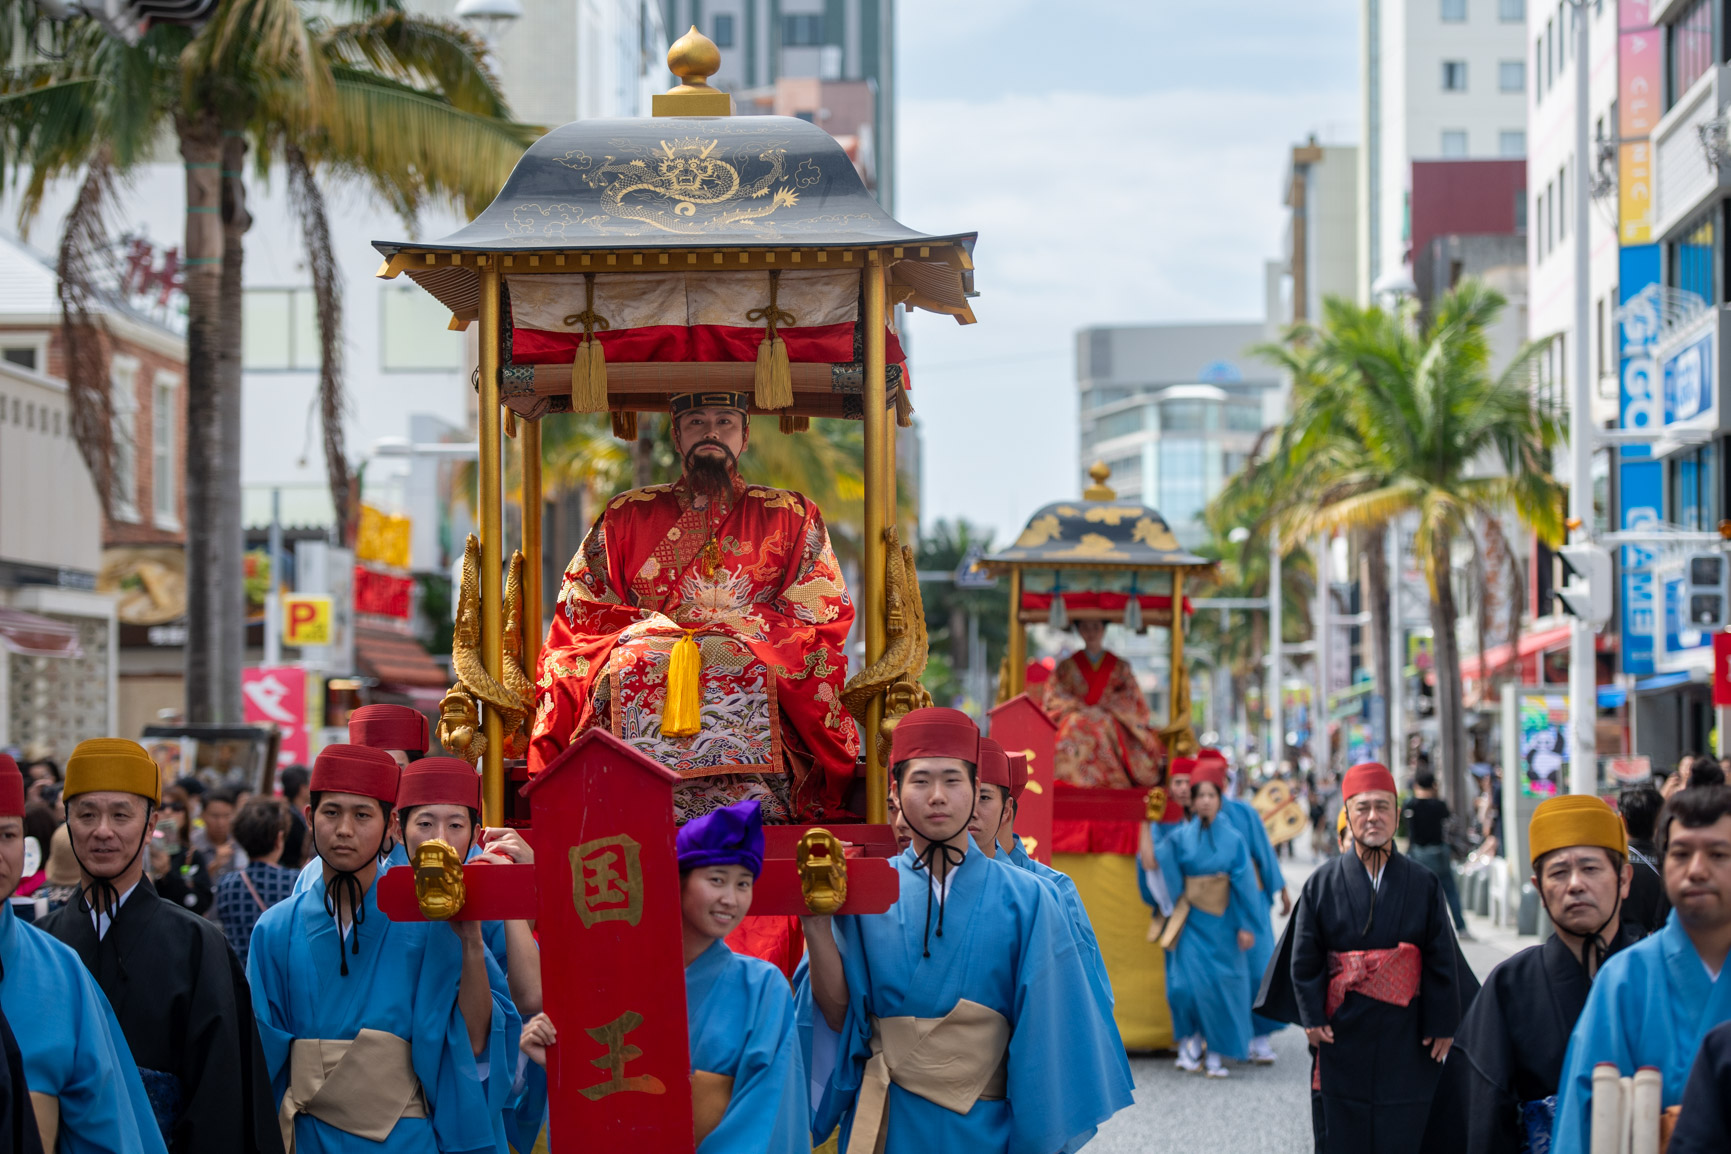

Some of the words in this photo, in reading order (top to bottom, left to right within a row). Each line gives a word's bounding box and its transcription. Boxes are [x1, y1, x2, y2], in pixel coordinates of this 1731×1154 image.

[1630, 76, 1649, 201] CLINIC
[288, 602, 316, 639] P
[568, 833, 667, 1101] 国王
